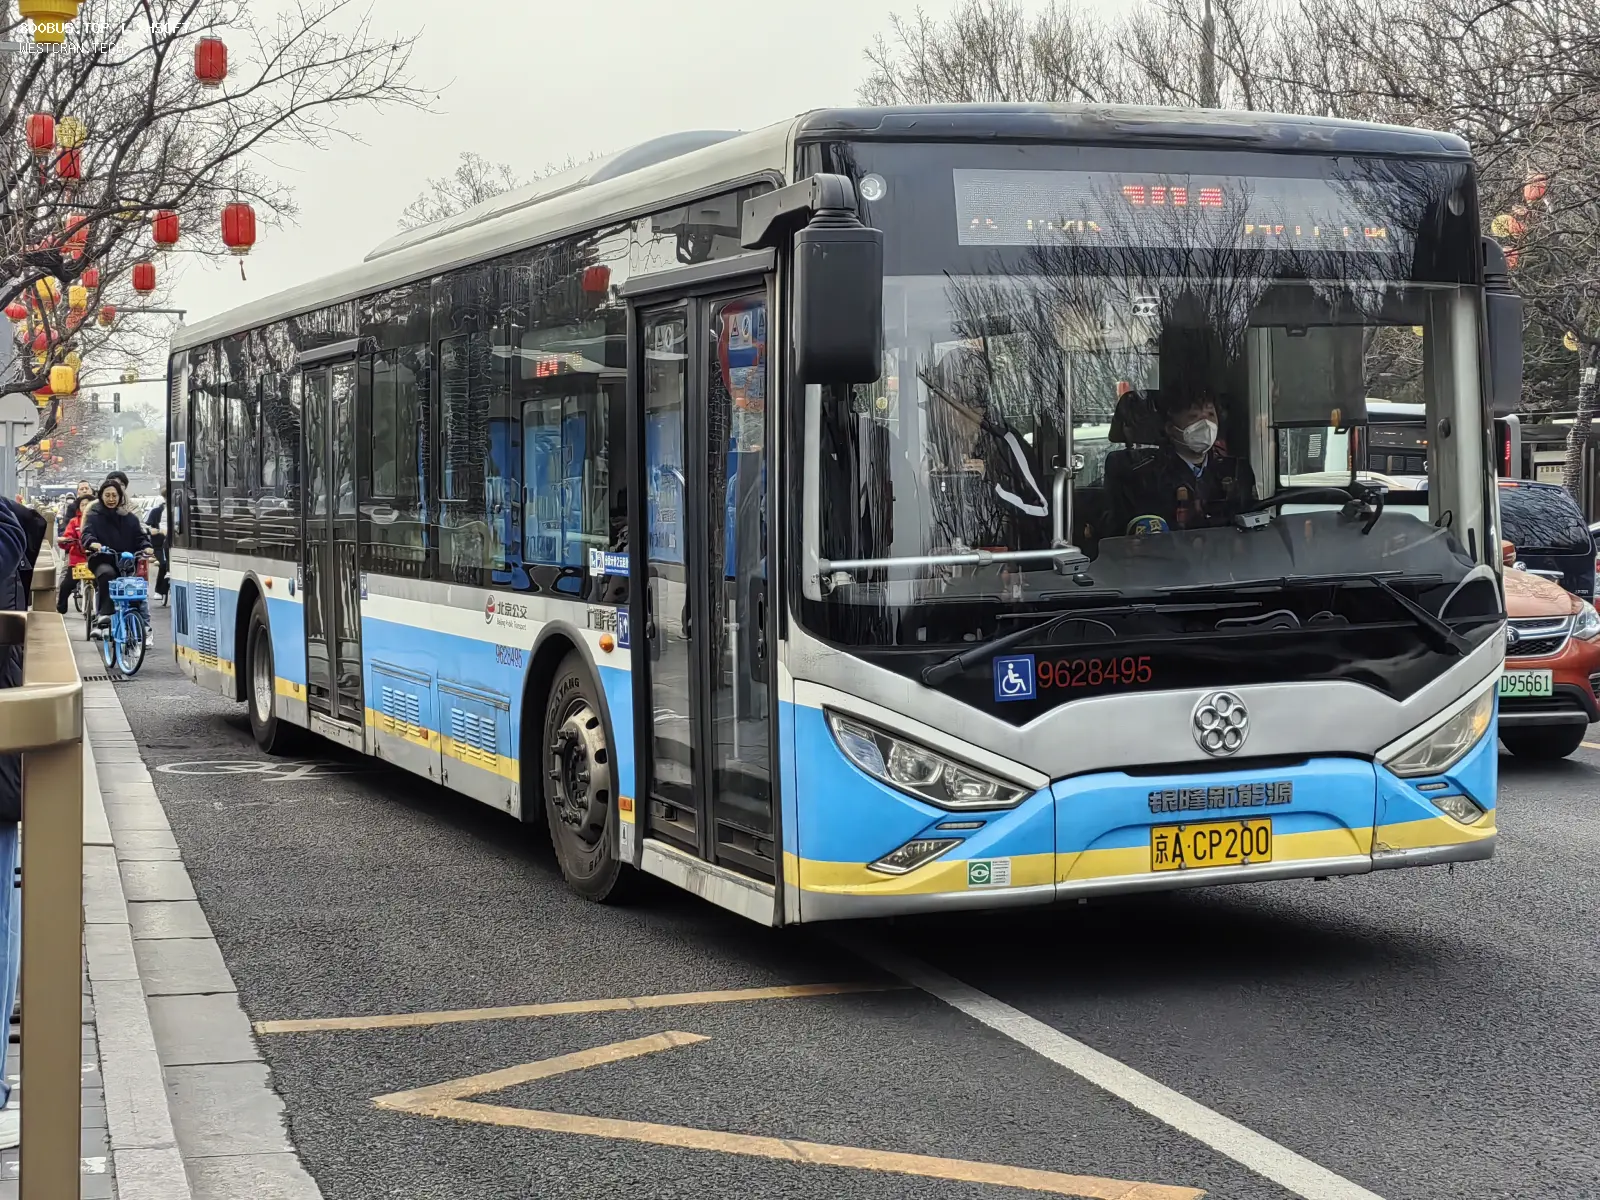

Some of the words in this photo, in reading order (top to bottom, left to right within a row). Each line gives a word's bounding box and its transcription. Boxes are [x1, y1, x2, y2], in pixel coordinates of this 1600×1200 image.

[497, 601, 527, 619] 北京公交
[1037, 655, 1152, 689] 9628495
[1501, 674, 1550, 693] D95661
[1148, 780, 1293, 814] 银隆新能源
[1155, 826, 1269, 864] 京A·CP200
